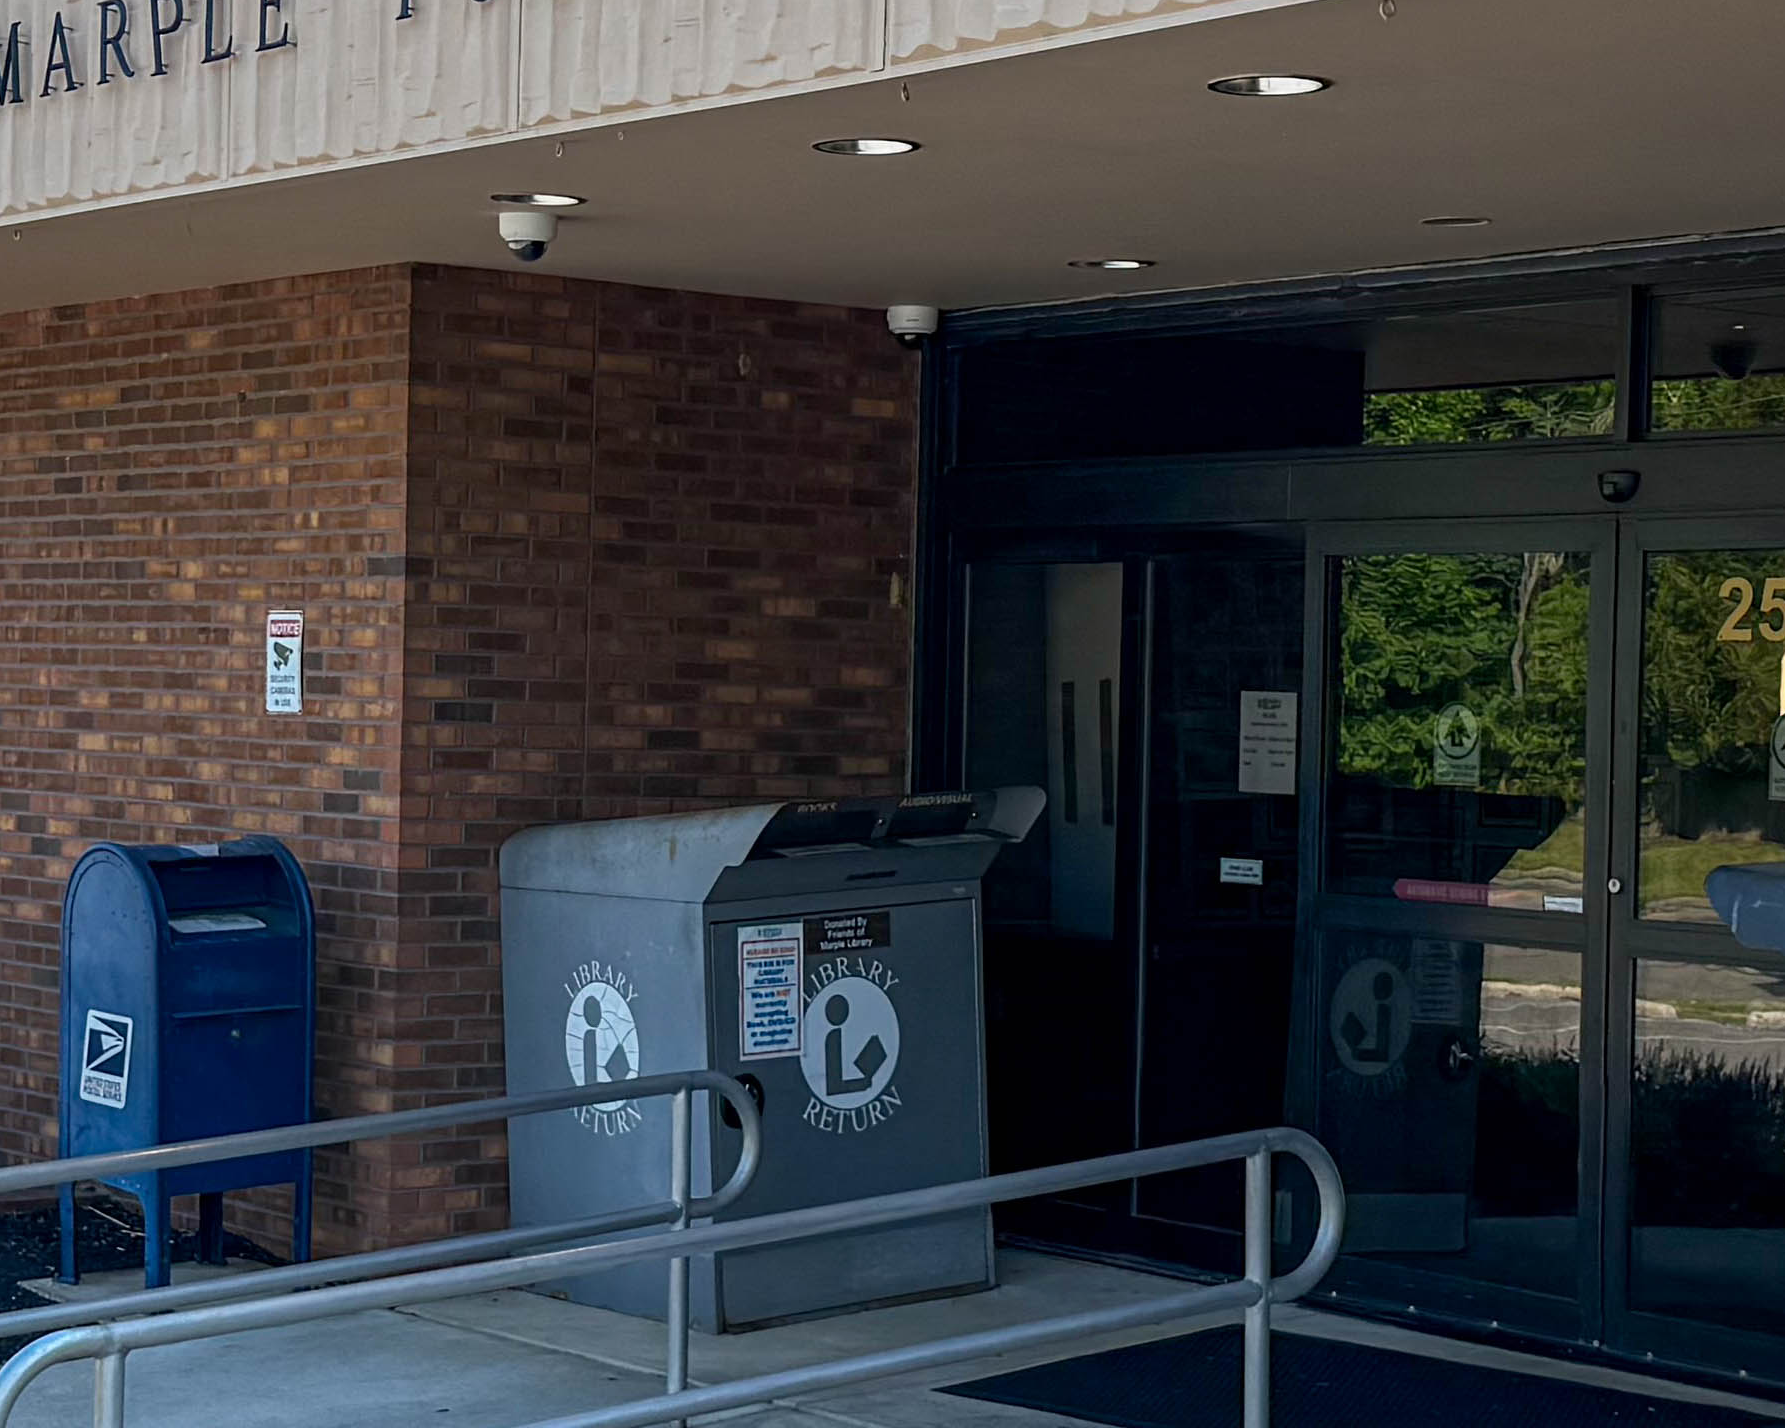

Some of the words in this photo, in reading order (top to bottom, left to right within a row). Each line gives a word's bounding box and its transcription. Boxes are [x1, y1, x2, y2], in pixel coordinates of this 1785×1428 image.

[564, 960, 639, 1002] LIBRARY
[802, 956, 899, 1004] LIBRARY
[802, 1086, 903, 1134] RETURN
